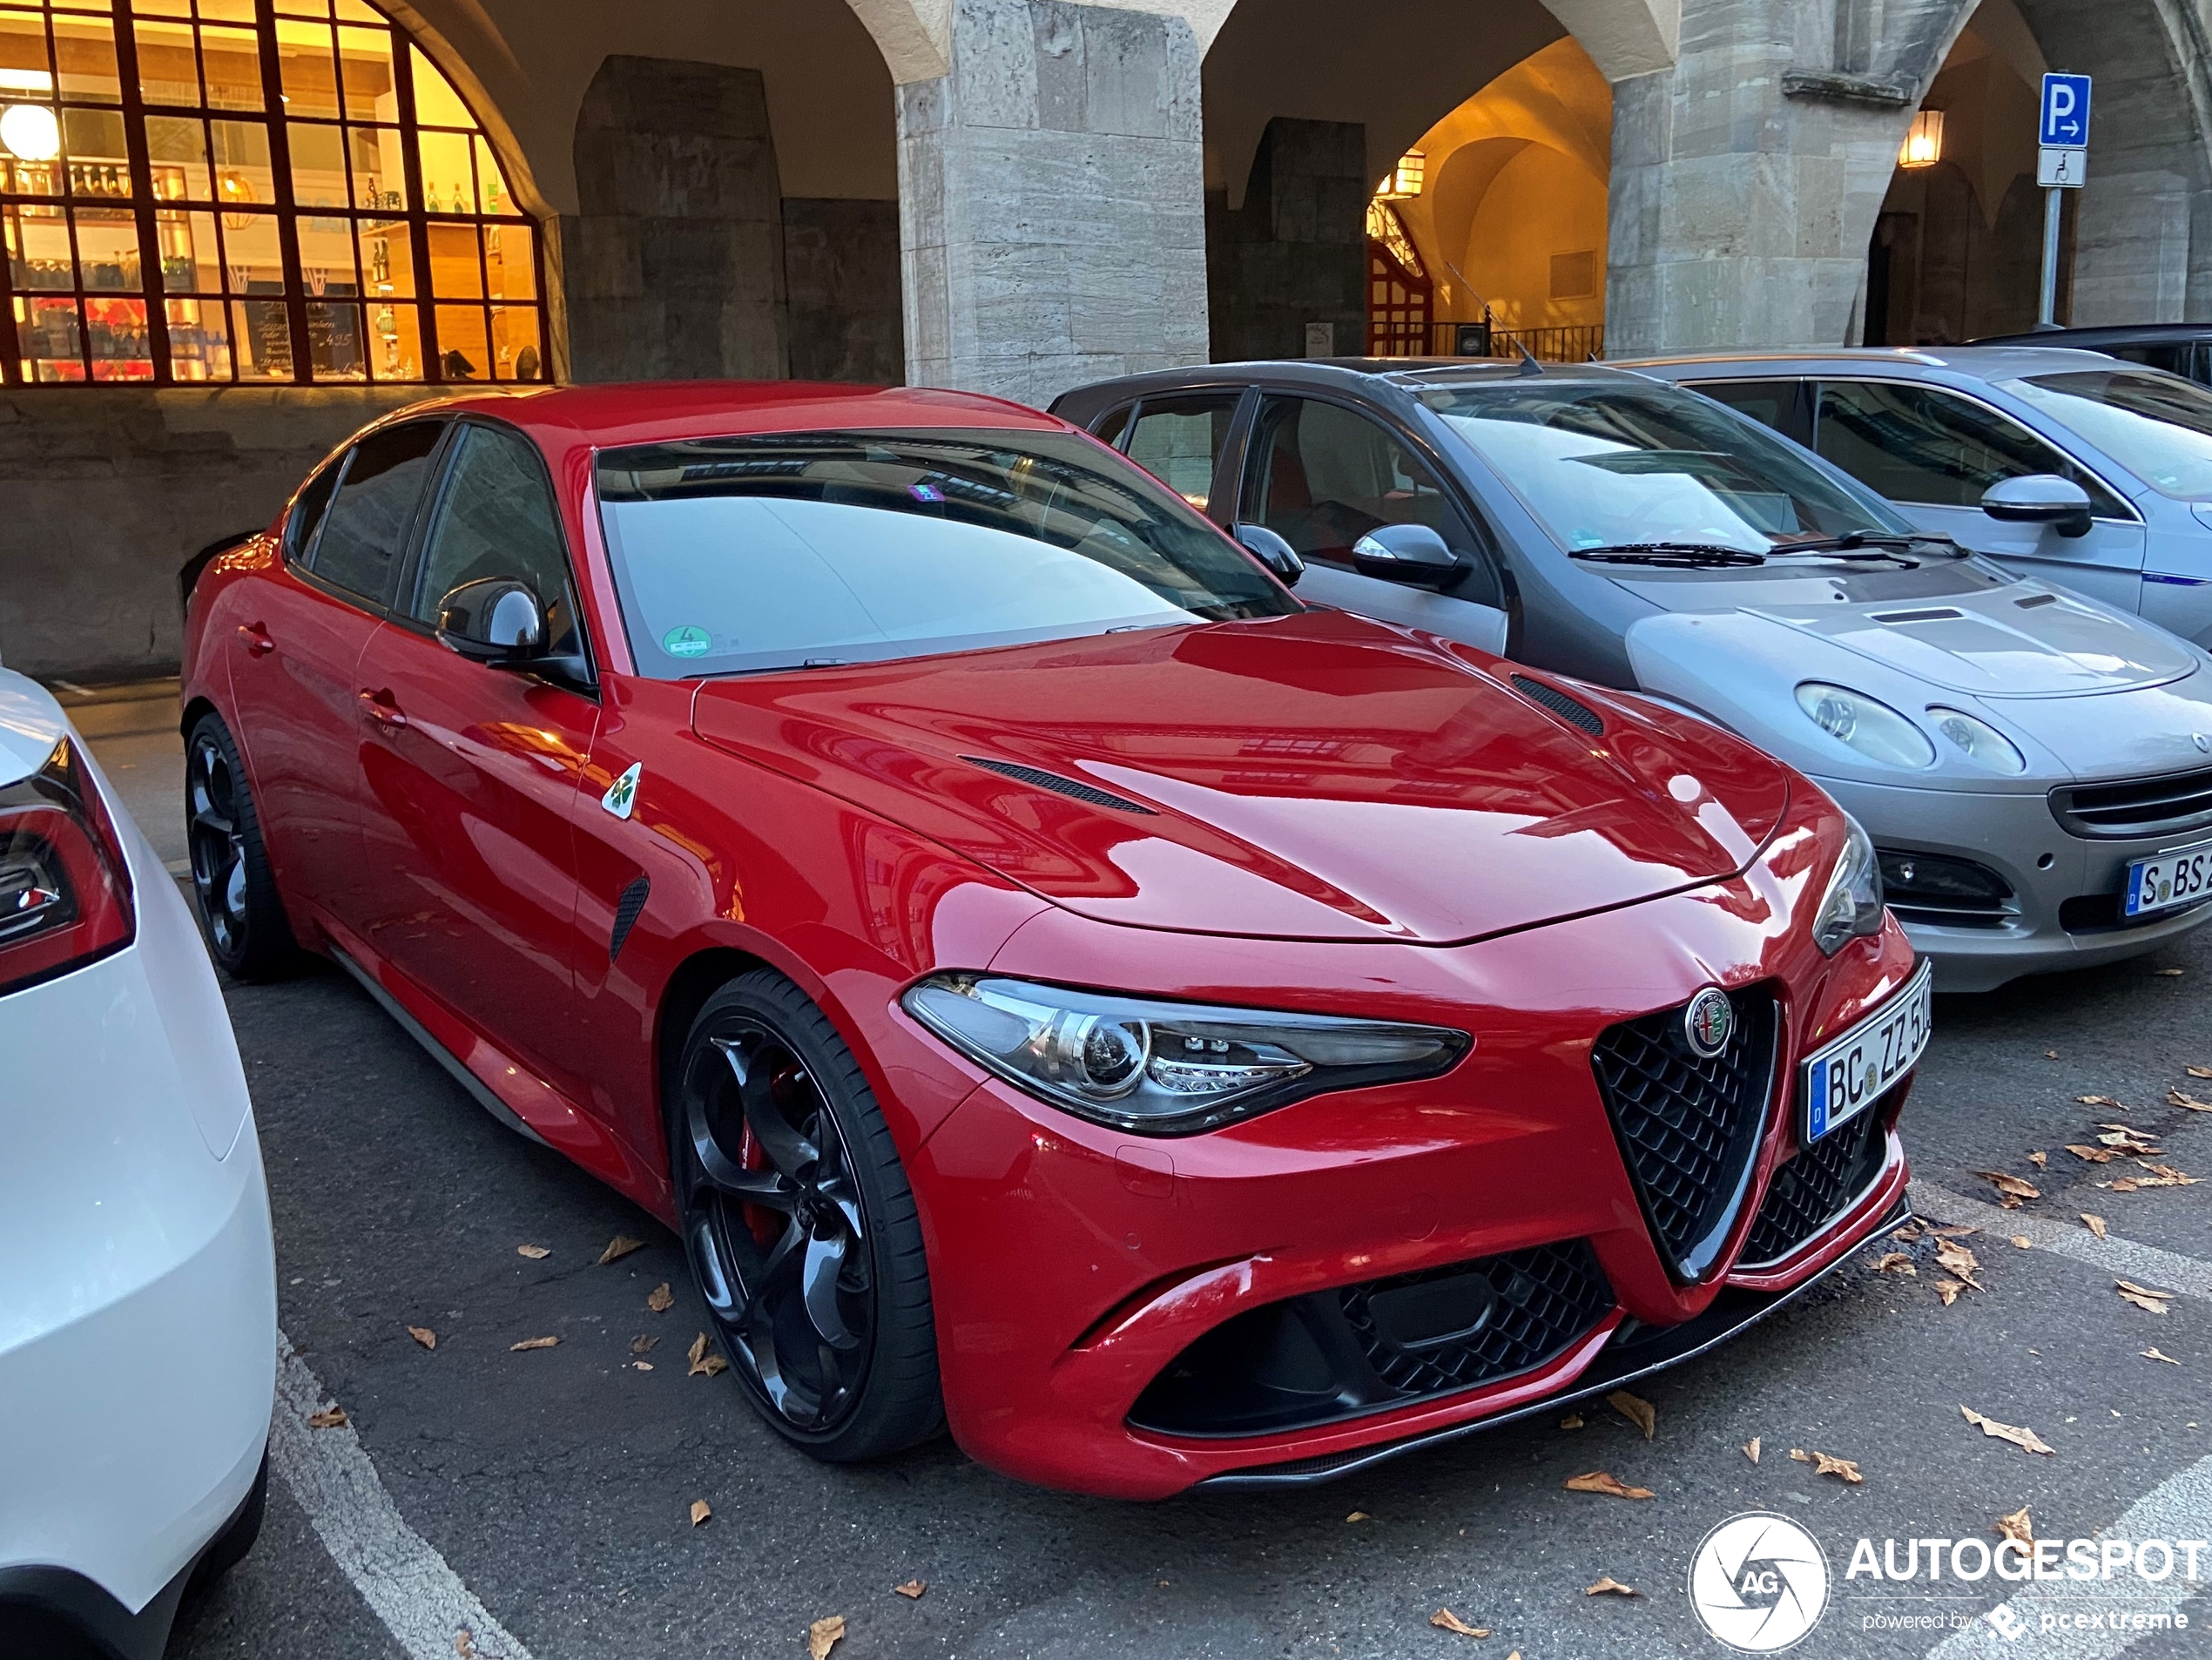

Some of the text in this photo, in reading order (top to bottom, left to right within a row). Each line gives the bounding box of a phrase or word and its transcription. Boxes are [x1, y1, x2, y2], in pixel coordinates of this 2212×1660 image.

[2048, 84, 2076, 136] P
[680, 627, 694, 642] 4
[2129, 894, 2136, 905] D
[2142, 867, 2159, 905] S
[2173, 854, 2204, 897] BS
[1694, 1002, 1706, 1028] ALFA
[1814, 1107, 1821, 1124] D
[1830, 1045, 1864, 1119] BC
[1881, 1009, 1907, 1083] ZZ
